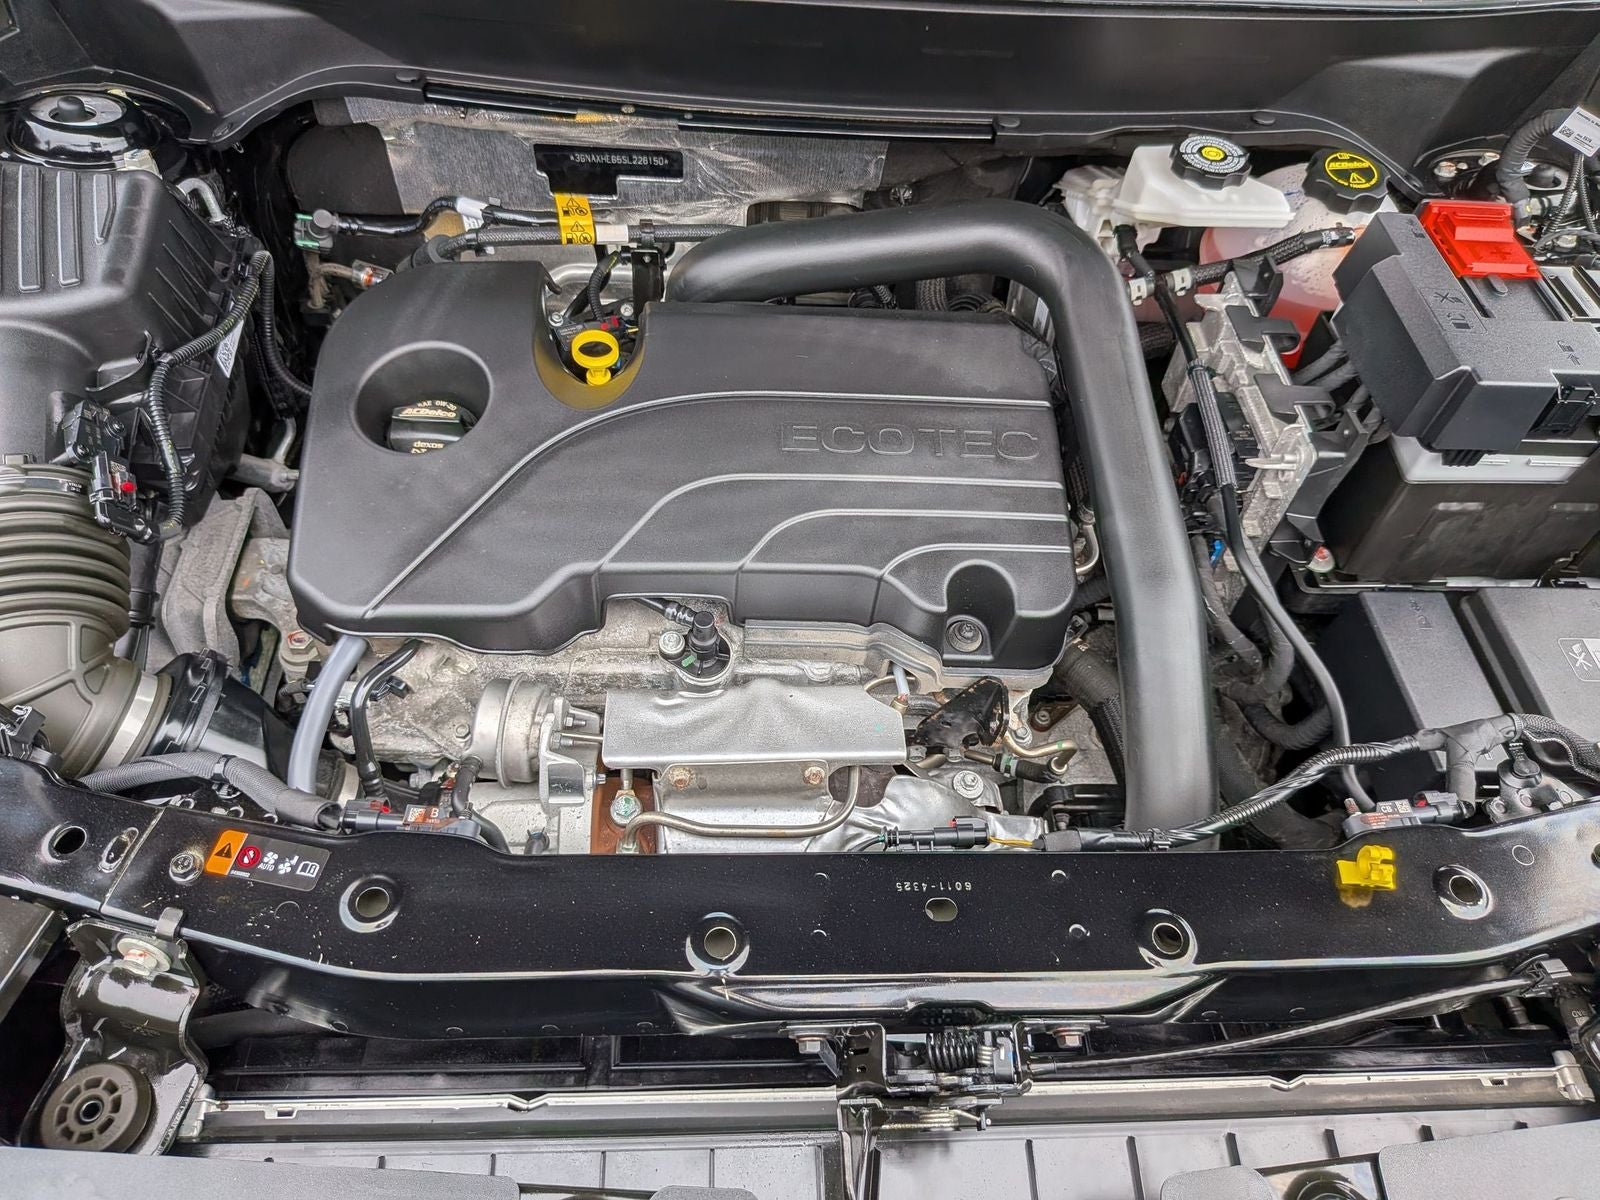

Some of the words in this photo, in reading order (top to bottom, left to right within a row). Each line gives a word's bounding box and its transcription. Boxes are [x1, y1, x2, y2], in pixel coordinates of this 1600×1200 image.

[1328, 161, 1370, 170] ACDelco
[435, 400, 457, 411] 0W-20
[400, 408, 456, 418] ACDelco
[413, 440, 445, 449] dexos
[781, 420, 1040, 461] ECOTEC
[430, 807, 439, 818] B
[257, 862, 275, 872] AUTO
[896, 881, 972, 892] 6011-4325
